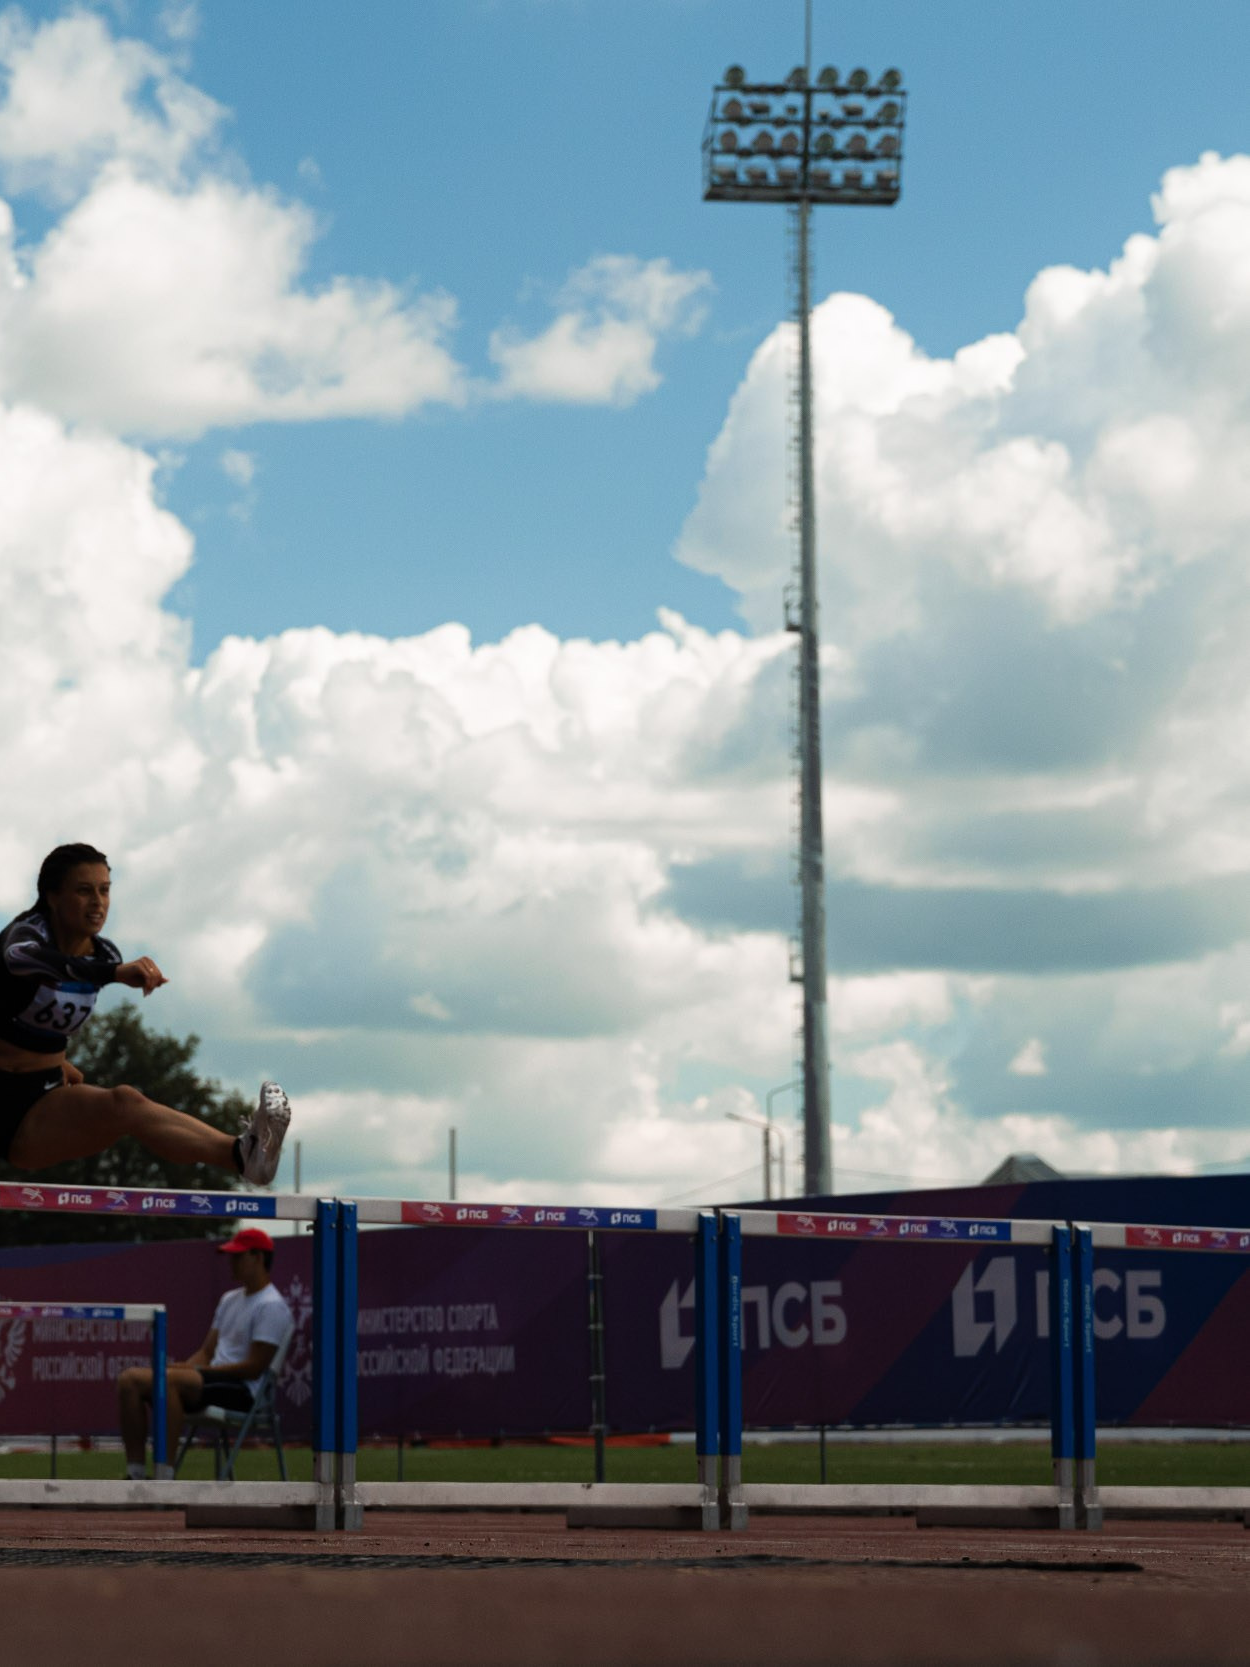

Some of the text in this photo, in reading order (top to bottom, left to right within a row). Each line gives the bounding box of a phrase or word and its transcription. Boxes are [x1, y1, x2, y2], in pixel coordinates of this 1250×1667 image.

[34, 999, 91, 1032] 637
[71, 1194, 92, 1205] ПСБ
[155, 1197, 176, 1209] ПСБ
[238, 1201, 259, 1212] ПСБ
[468, 1209, 489, 1219] ПСБ
[546, 1210, 566, 1221] ПСБ
[622, 1213, 641, 1224] ПСБ
[357, 1304, 499, 1335] ИНИСТЕРСТВО СПОРТА
[741, 1279, 847, 1350] ПСБ
[357, 1344, 430, 1376] ССИЙСКОЙ
